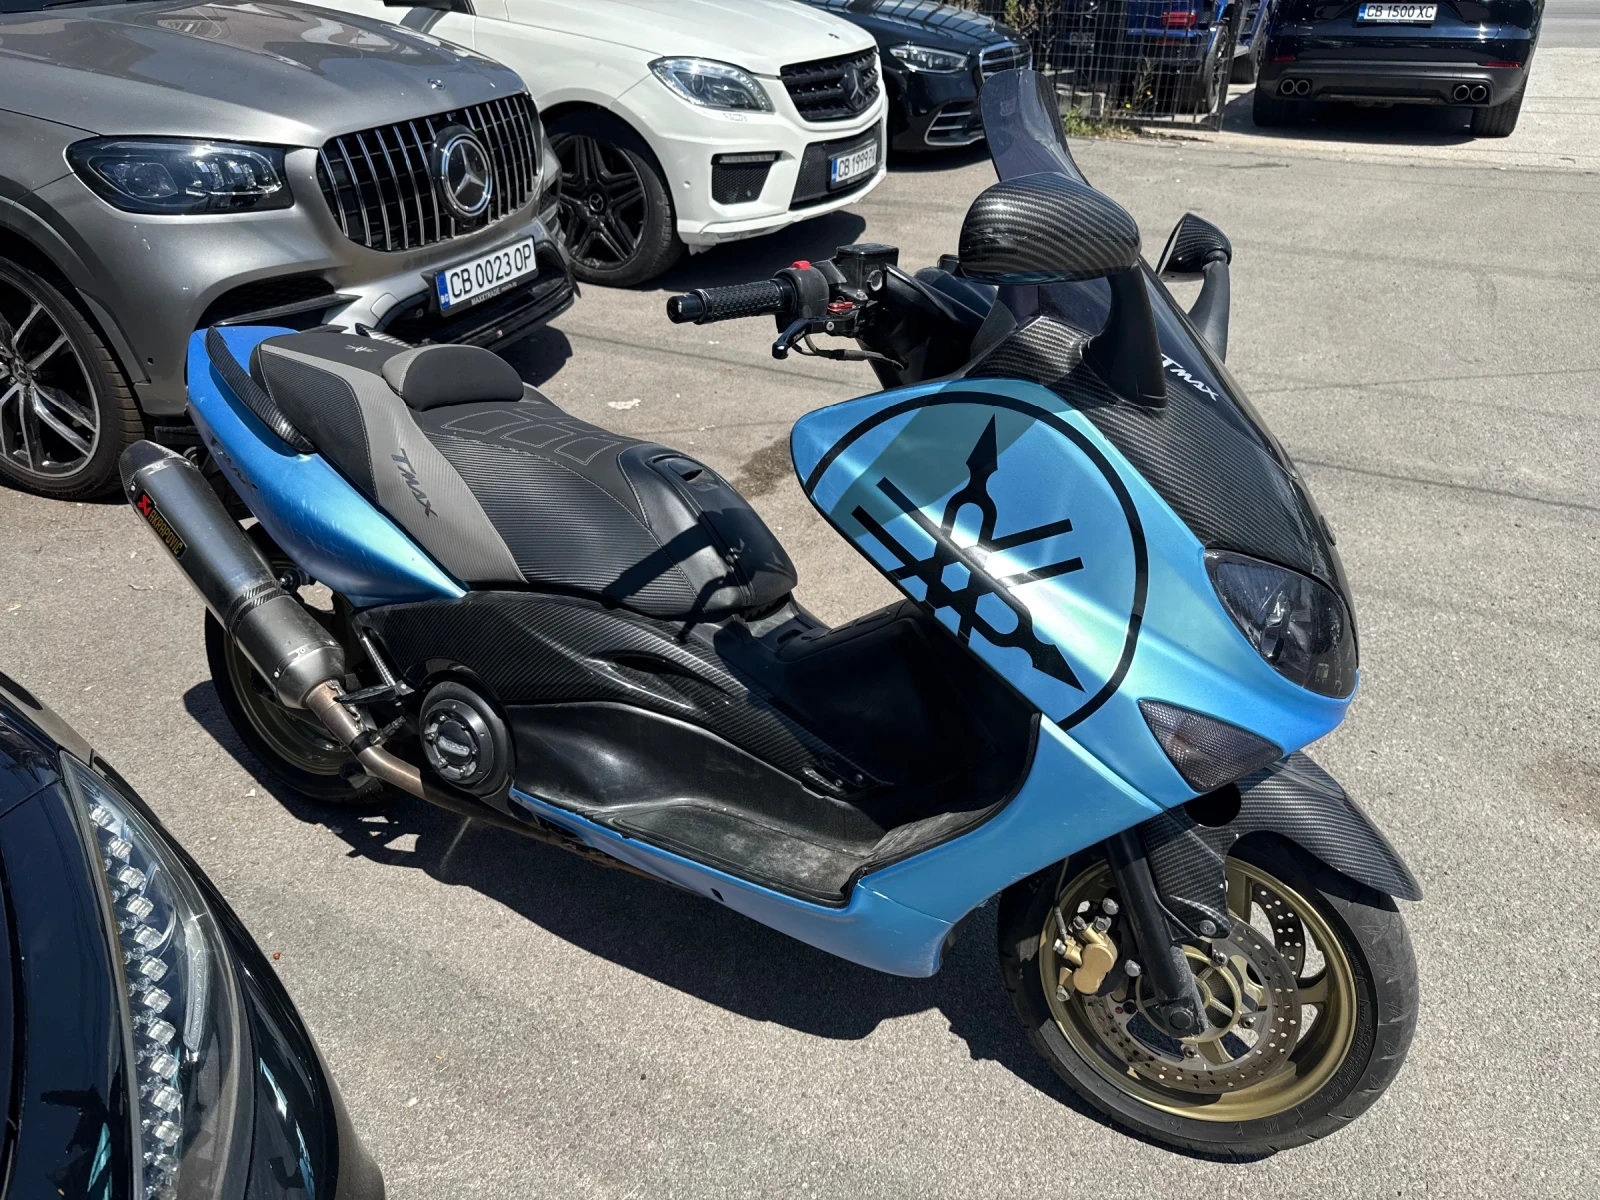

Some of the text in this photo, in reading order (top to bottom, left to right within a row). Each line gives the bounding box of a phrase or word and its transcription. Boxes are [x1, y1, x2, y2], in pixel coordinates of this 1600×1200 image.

[1367, 5, 1434, 18] CB 1500 XC
[839, 158, 850, 178] CB
[450, 243, 532, 299] CB 0023 OP
[441, 293, 449, 304] BG
